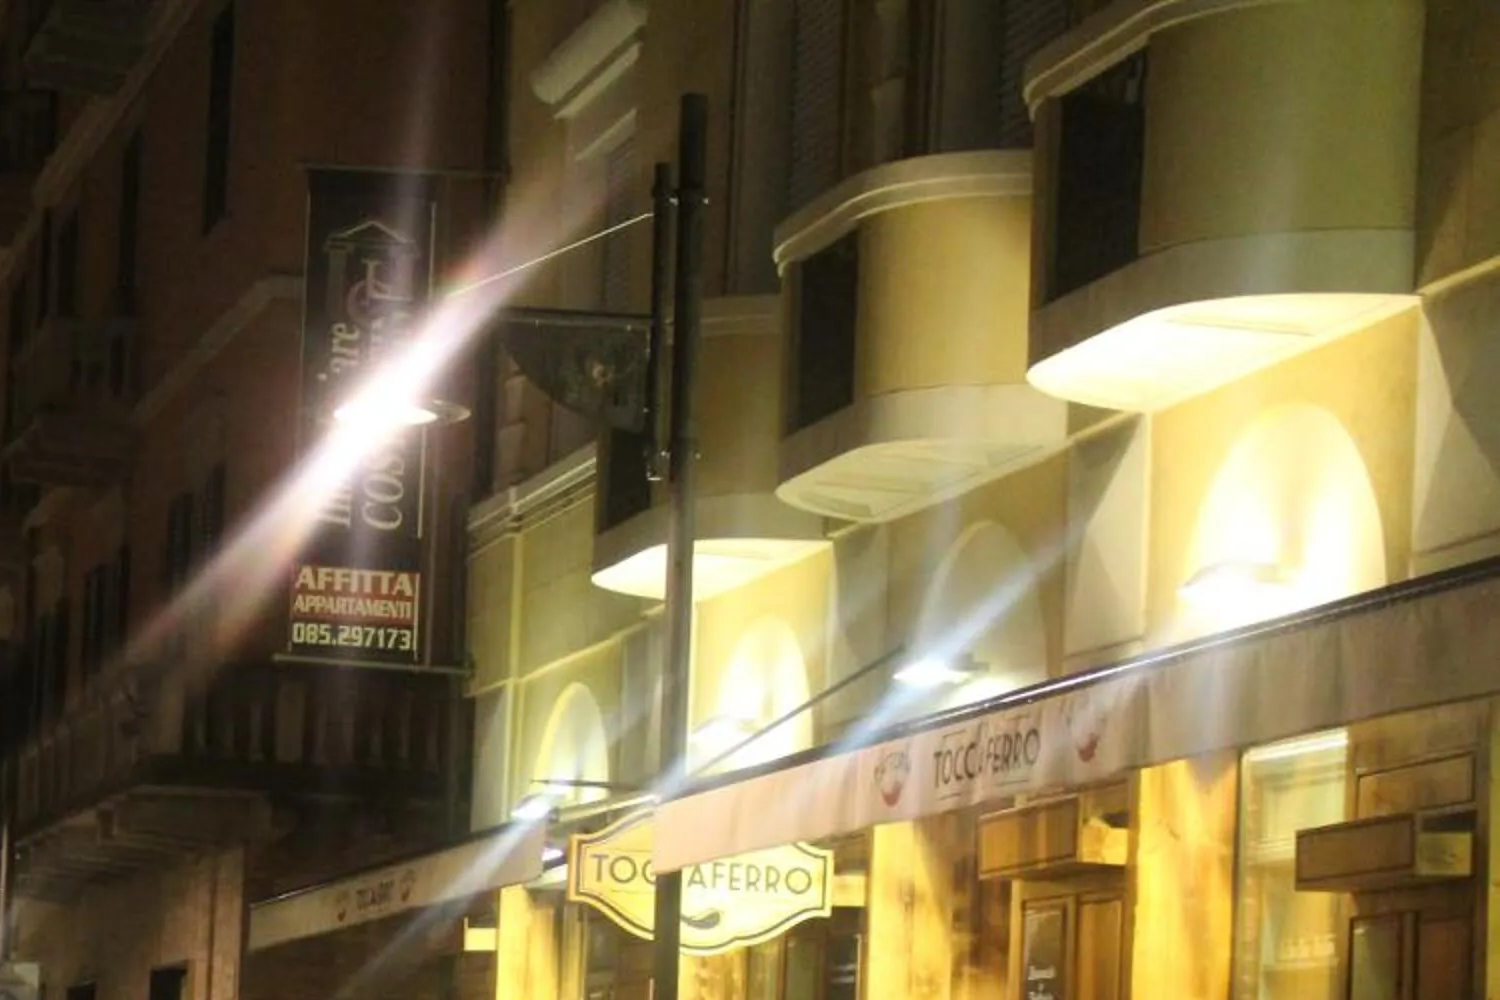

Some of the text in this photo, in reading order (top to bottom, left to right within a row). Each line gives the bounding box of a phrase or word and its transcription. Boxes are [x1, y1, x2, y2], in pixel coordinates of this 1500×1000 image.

[295, 565, 413, 597] AFFITTA
[294, 594, 412, 619] APPARTAMENTI
[292, 622, 412, 651] 085.297173
[933, 728, 1041, 789] TOCCFERRO
[589, 853, 813, 895] TOCAFERRO
